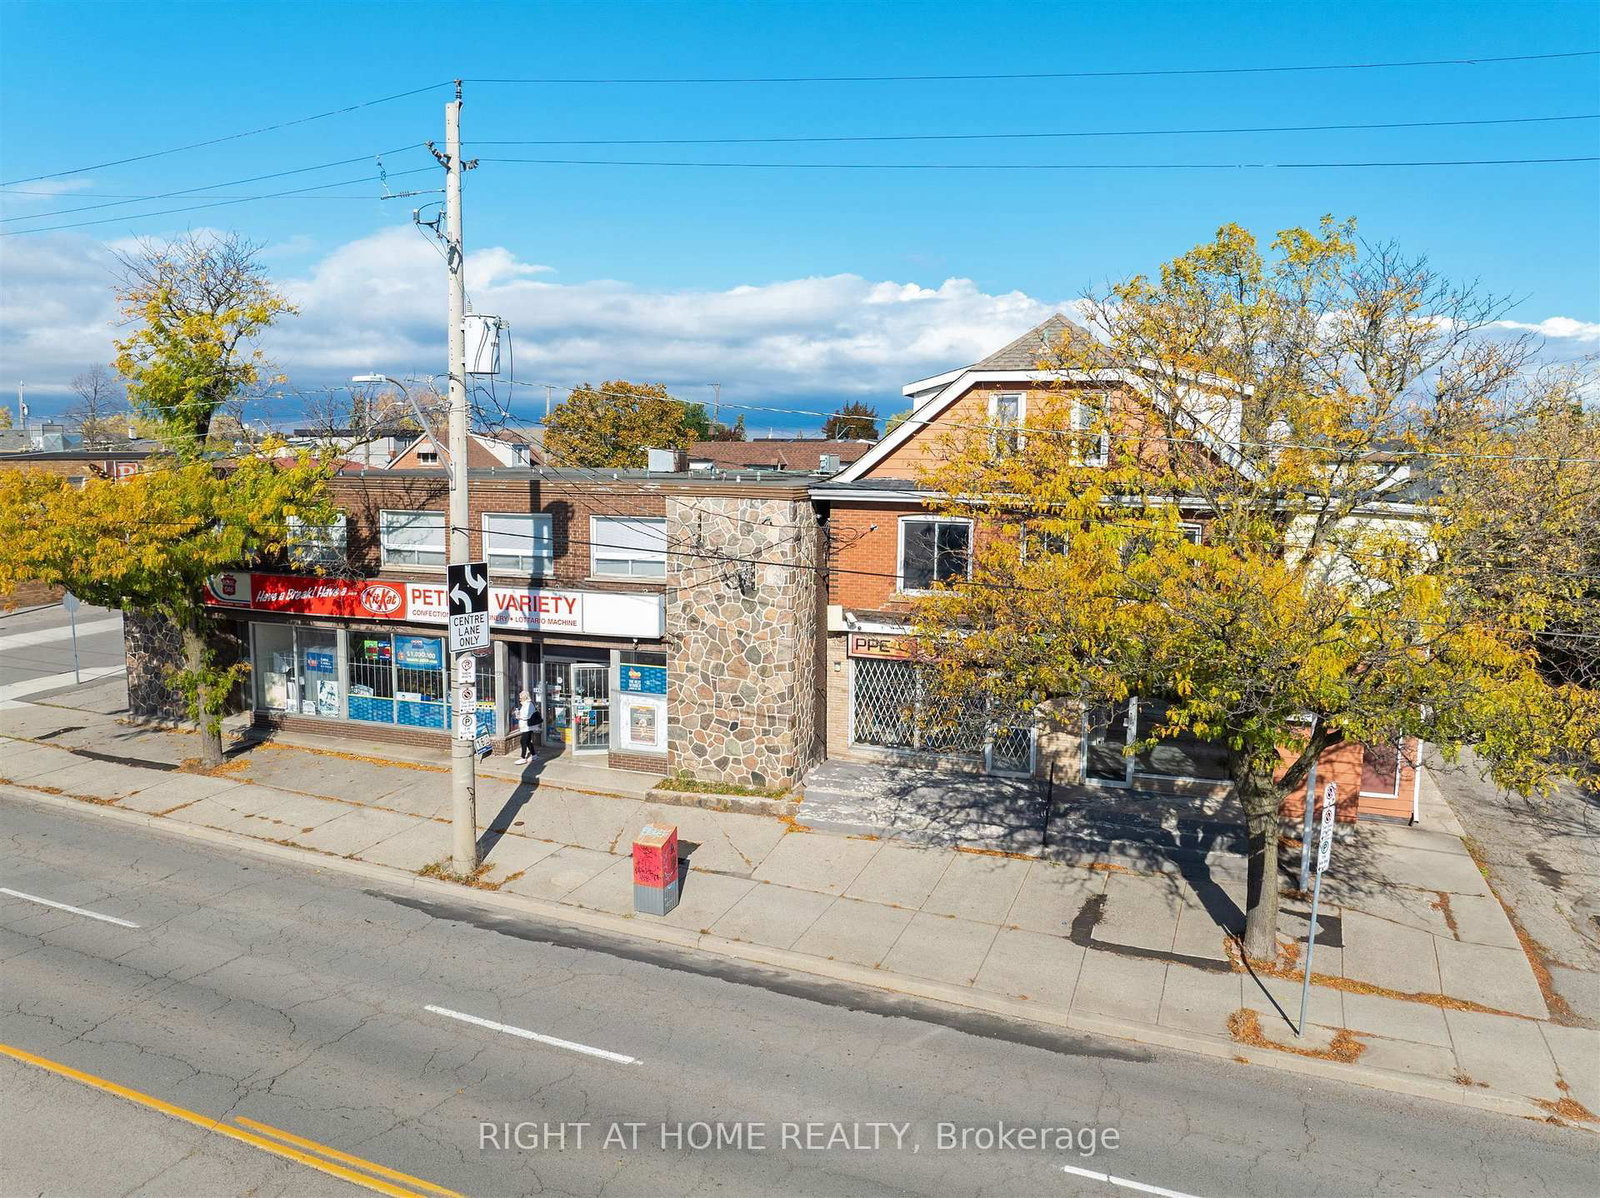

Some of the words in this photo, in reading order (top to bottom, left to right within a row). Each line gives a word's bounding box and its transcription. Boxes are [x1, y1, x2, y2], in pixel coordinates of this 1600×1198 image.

[255, 590, 278, 603] Have
[278, 592, 286, 601] a
[286, 585, 315, 601] Break!
[316, 584, 339, 600] Have
[411, 588, 449, 607] PET
[495, 593, 577, 615] VARIETY
[453, 613, 485, 628] CENTRE
[515, 615, 546, 625] LOTTARIO
[547, 617, 578, 627] MACHINE
[458, 625, 481, 637] LANE
[459, 635, 480, 648] ONLY
[855, 638, 891, 653] PPE
